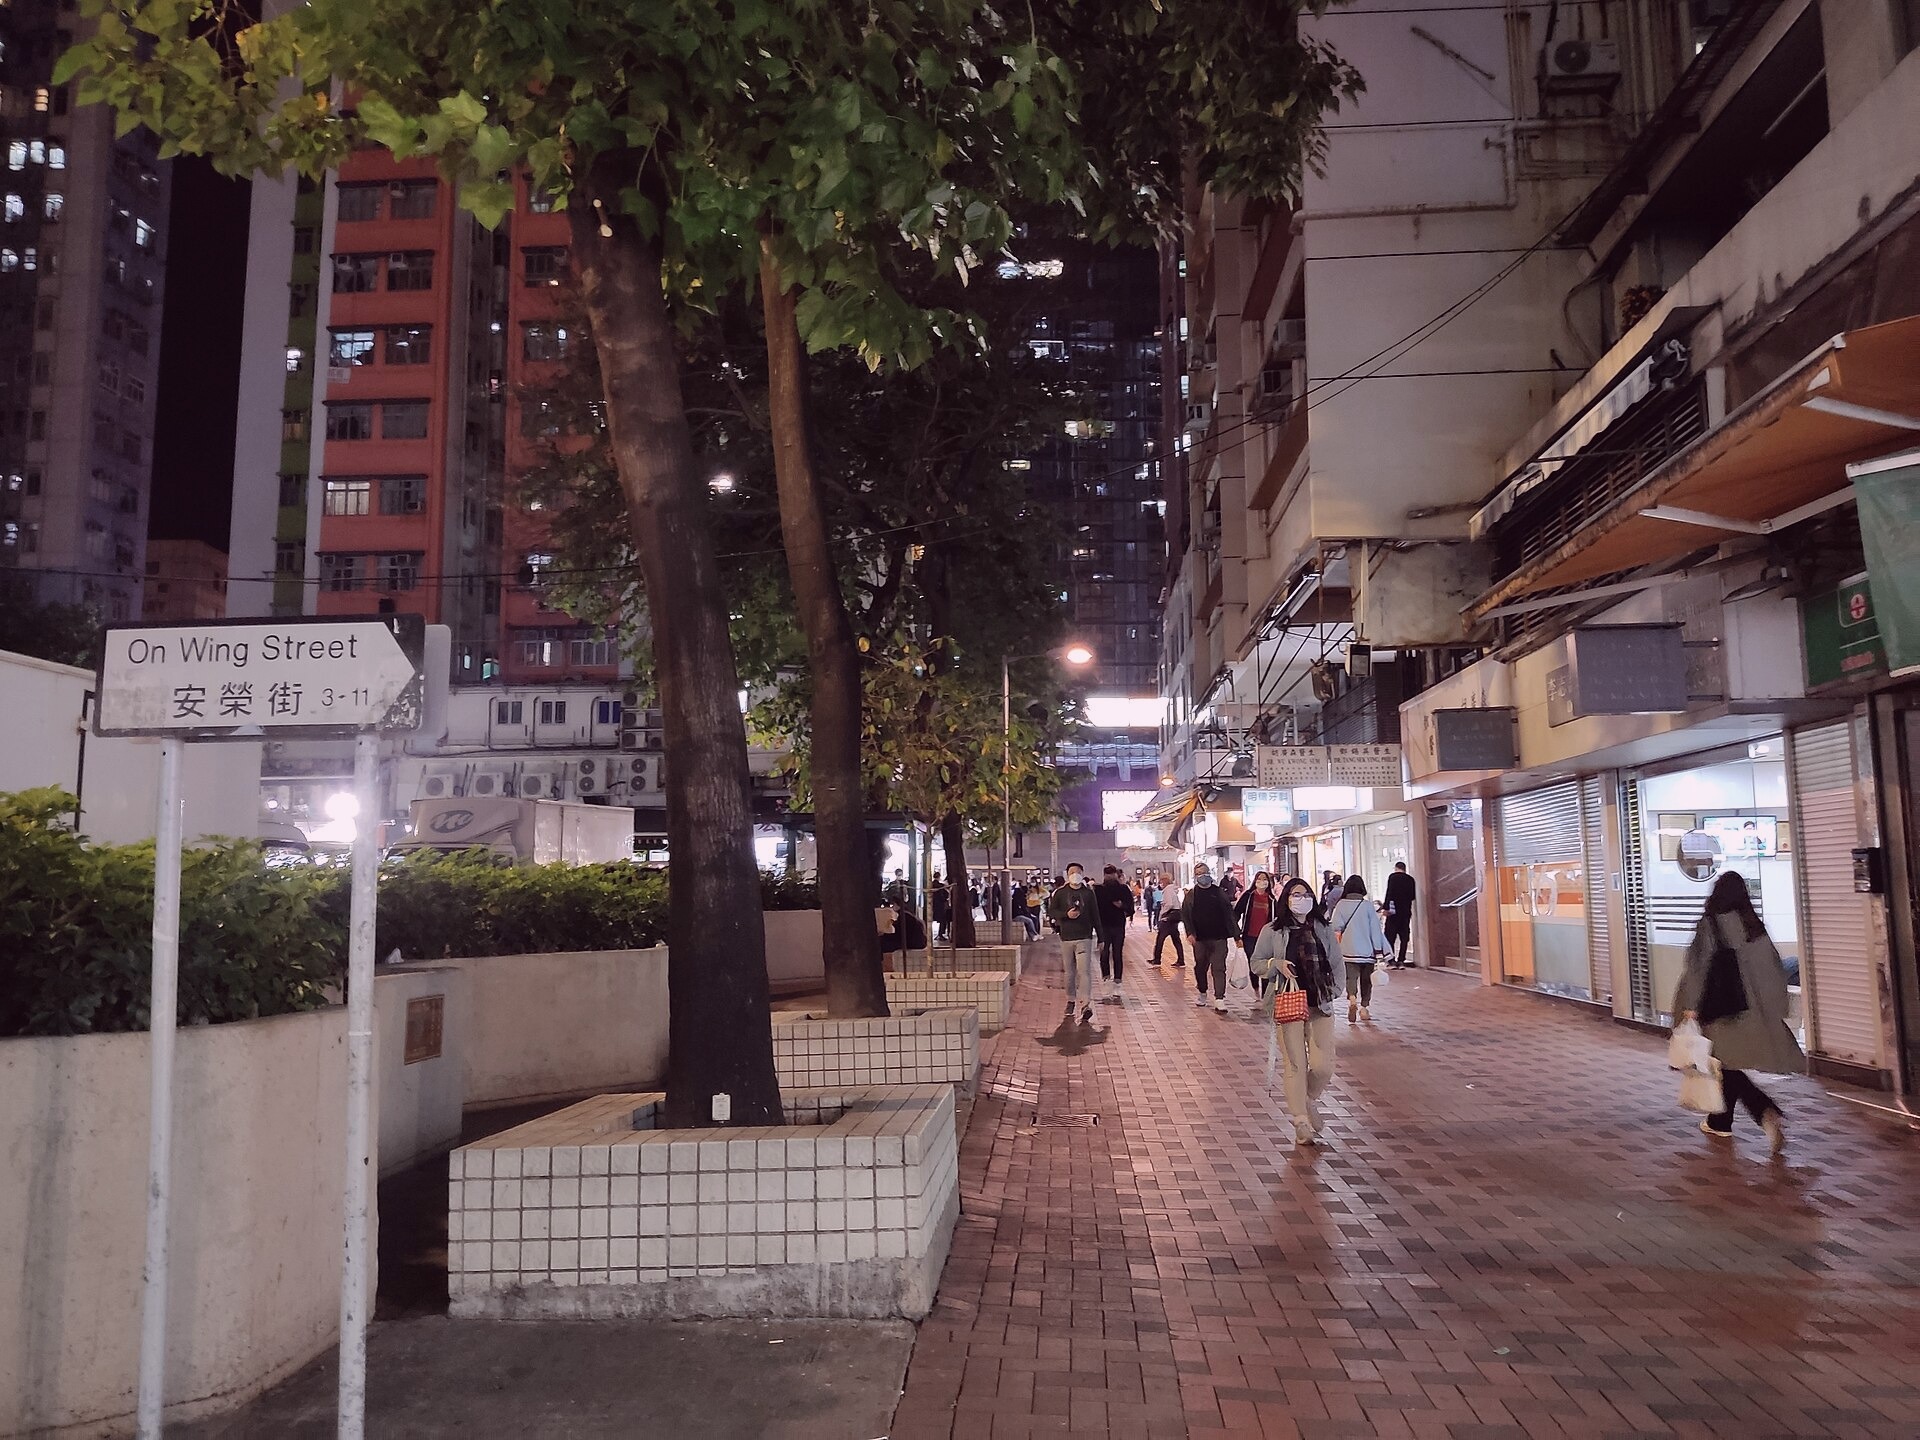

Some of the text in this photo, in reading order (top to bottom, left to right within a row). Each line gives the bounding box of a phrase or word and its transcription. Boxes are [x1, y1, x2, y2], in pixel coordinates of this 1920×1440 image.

[127, 633, 358, 667] On Wing Street
[173, 682, 369, 719] 安榮街 3-11
